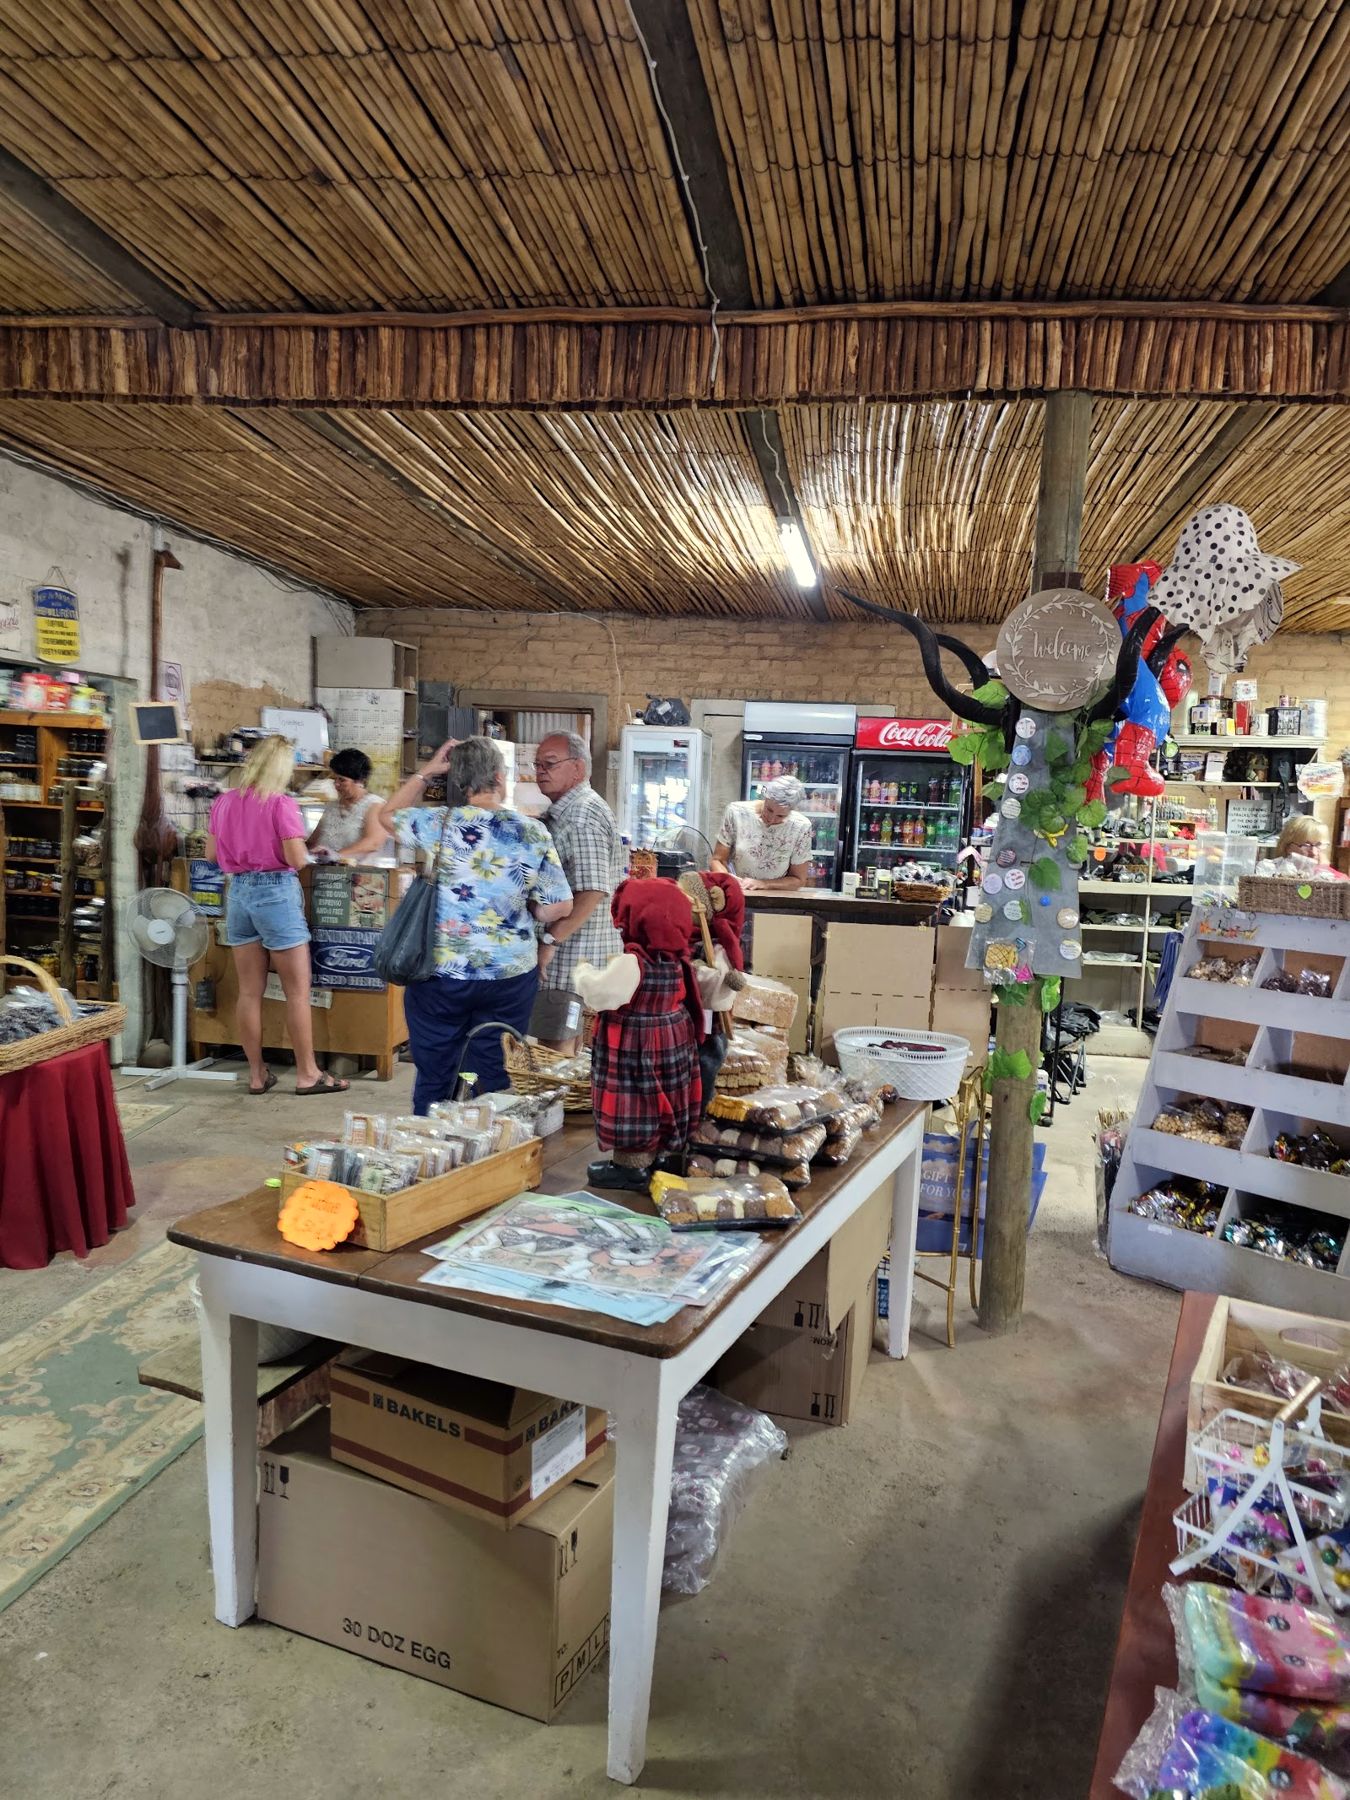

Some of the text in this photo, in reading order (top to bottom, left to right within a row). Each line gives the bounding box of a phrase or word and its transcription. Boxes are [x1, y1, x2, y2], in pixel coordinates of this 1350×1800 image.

[1033, 626, 1092, 662] Welcome
[324, 947, 372, 969] Ford
[313, 974, 347, 985] USED
[920, 1185, 944, 1198] FOR
[922, 1170, 951, 1184] GIFT
[386, 1398, 461, 1438] BAKELS
[342, 1617, 451, 1670] 30 DOZ EGG
[560, 1670, 570, 1692] P
[576, 1650, 586, 1673] M
